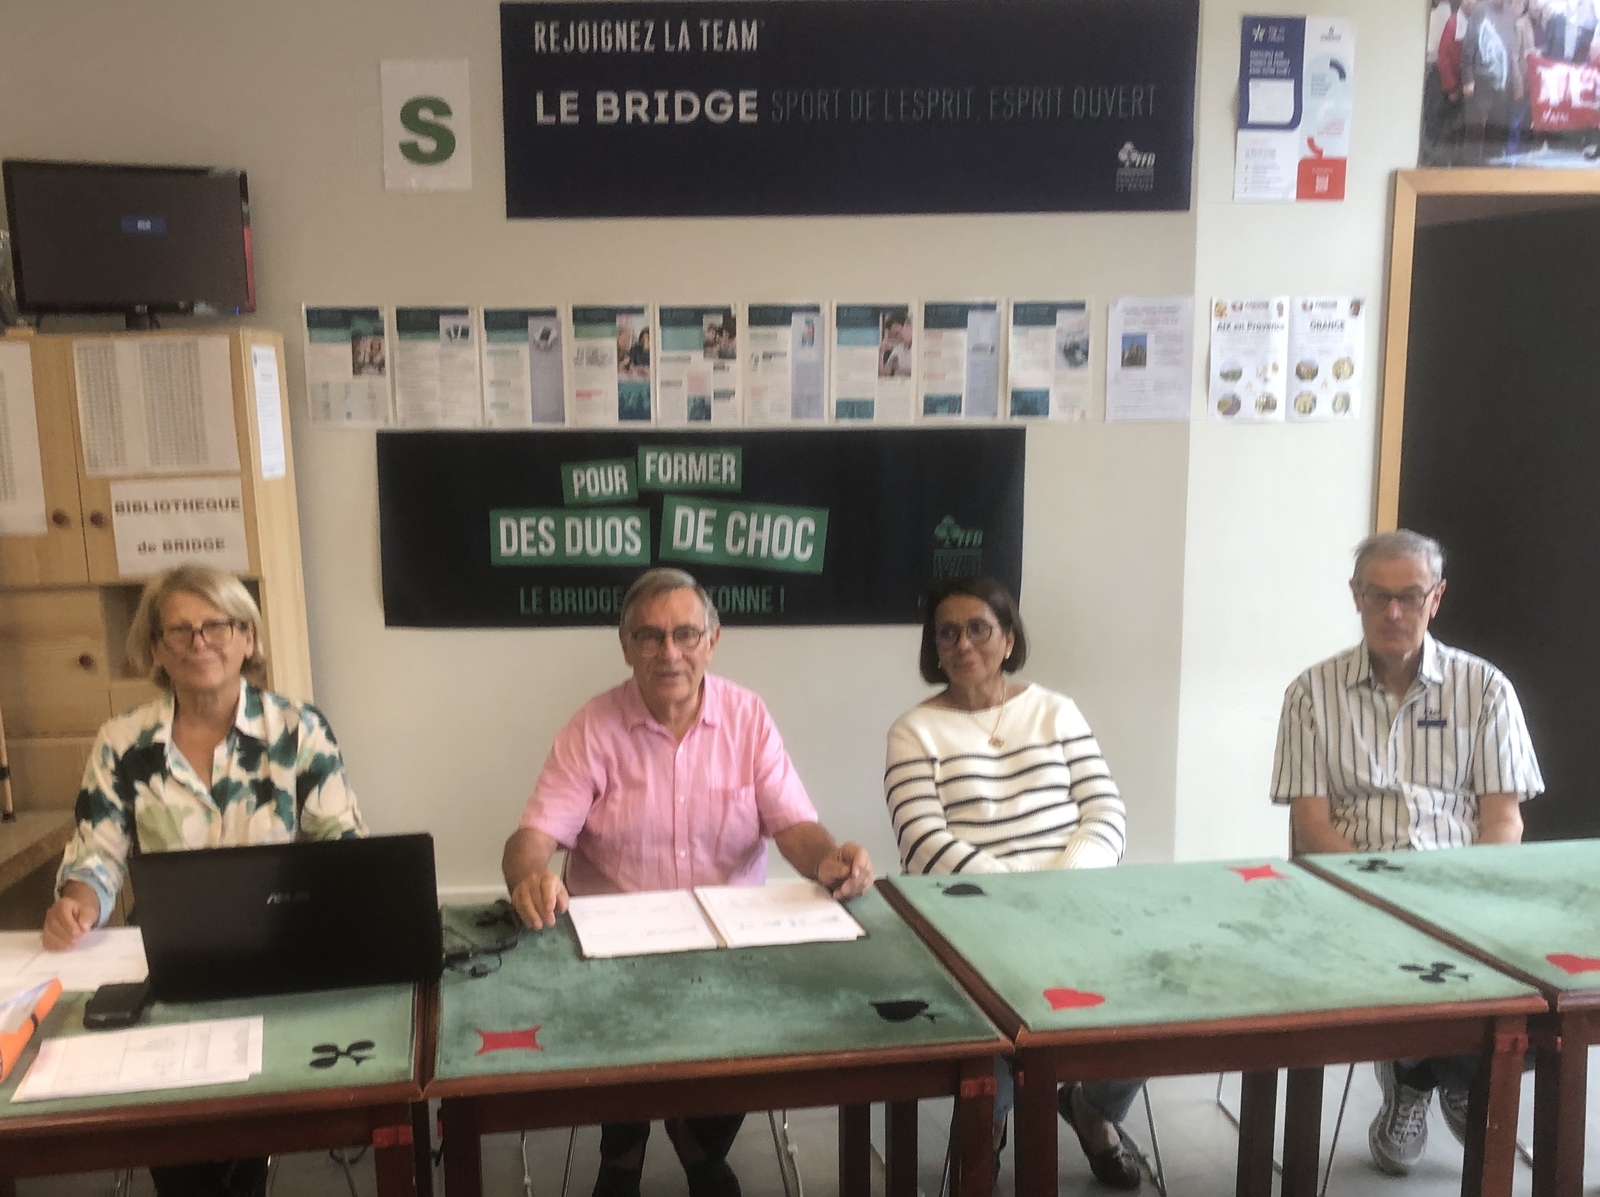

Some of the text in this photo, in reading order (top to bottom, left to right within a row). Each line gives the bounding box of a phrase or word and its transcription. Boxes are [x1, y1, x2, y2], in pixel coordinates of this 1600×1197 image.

[535, 19, 656, 54] REJOIGNEZ
[664, 19, 691, 53] LA
[535, 90, 580, 125] LE
[596, 89, 759, 125] BRIDGE
[771, 87, 842, 123] SPORT
[850, 87, 876, 122] DE
[989, 85, 1063, 121] ESPRIT
[1072, 83, 1157, 119] OUVERT
[399, 95, 456, 166] S
[572, 463, 629, 500] POUR
[645, 451, 737, 486] FORMER
[114, 497, 241, 516] BIBLIOTHEQUE
[138, 537, 226, 556] de BRIDGE
[499, 516, 642, 558] DES DUOS
[671, 504, 816, 563] DE CHOC
[519, 586, 543, 616] LE
[549, 585, 626, 616] BRIDGE
